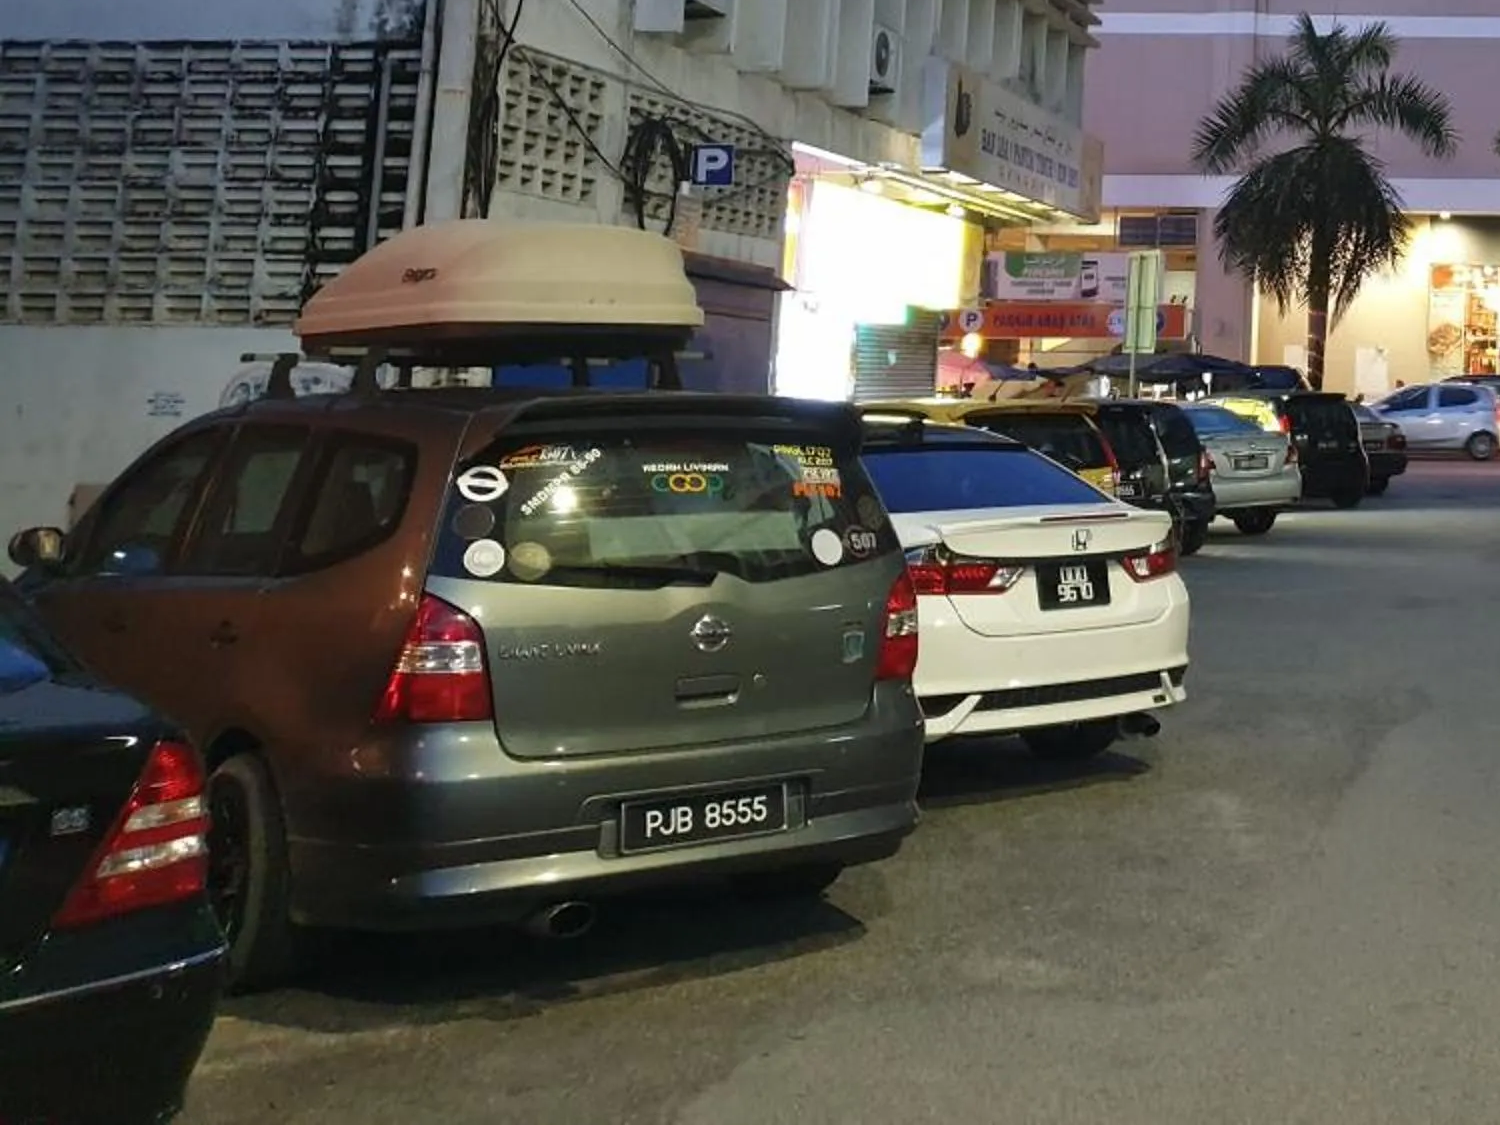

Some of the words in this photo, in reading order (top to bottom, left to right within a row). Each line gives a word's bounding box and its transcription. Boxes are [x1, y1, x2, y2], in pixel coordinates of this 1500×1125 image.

[697, 148, 729, 182] P
[965, 313, 978, 326] P
[645, 805, 694, 838] PJB
[704, 795, 768, 828] 8555
